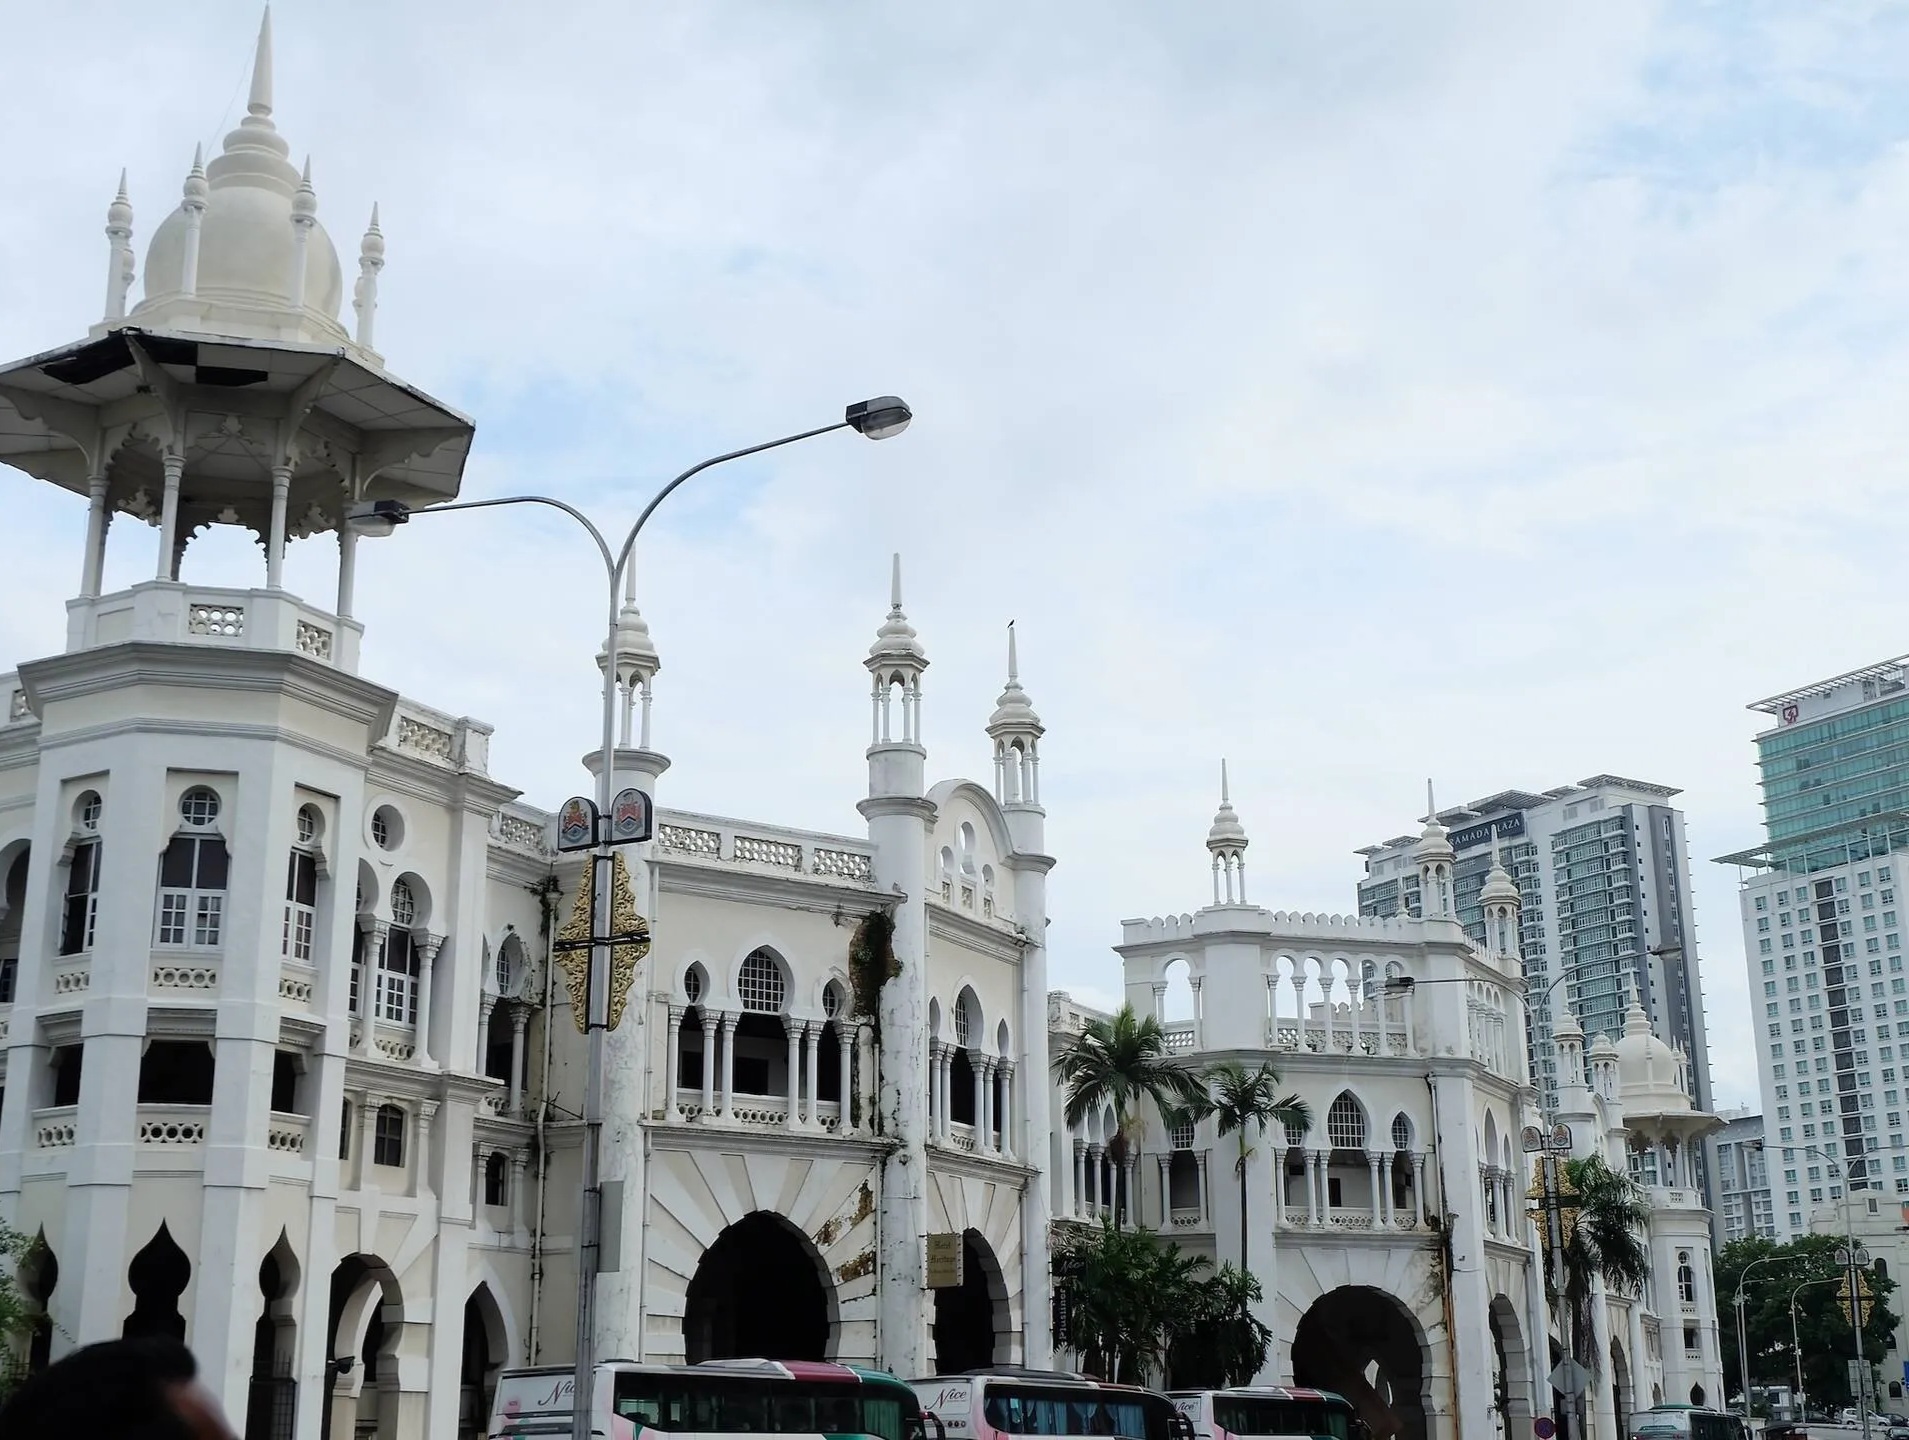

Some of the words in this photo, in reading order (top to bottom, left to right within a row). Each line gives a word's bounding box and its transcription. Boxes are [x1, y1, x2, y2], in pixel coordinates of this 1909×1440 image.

[1448, 828, 1490, 845] RAMADA
[1496, 818, 1521, 832] LAZA
[537, 1380, 576, 1406] Nic
[924, 1388, 967, 1410] Nice
